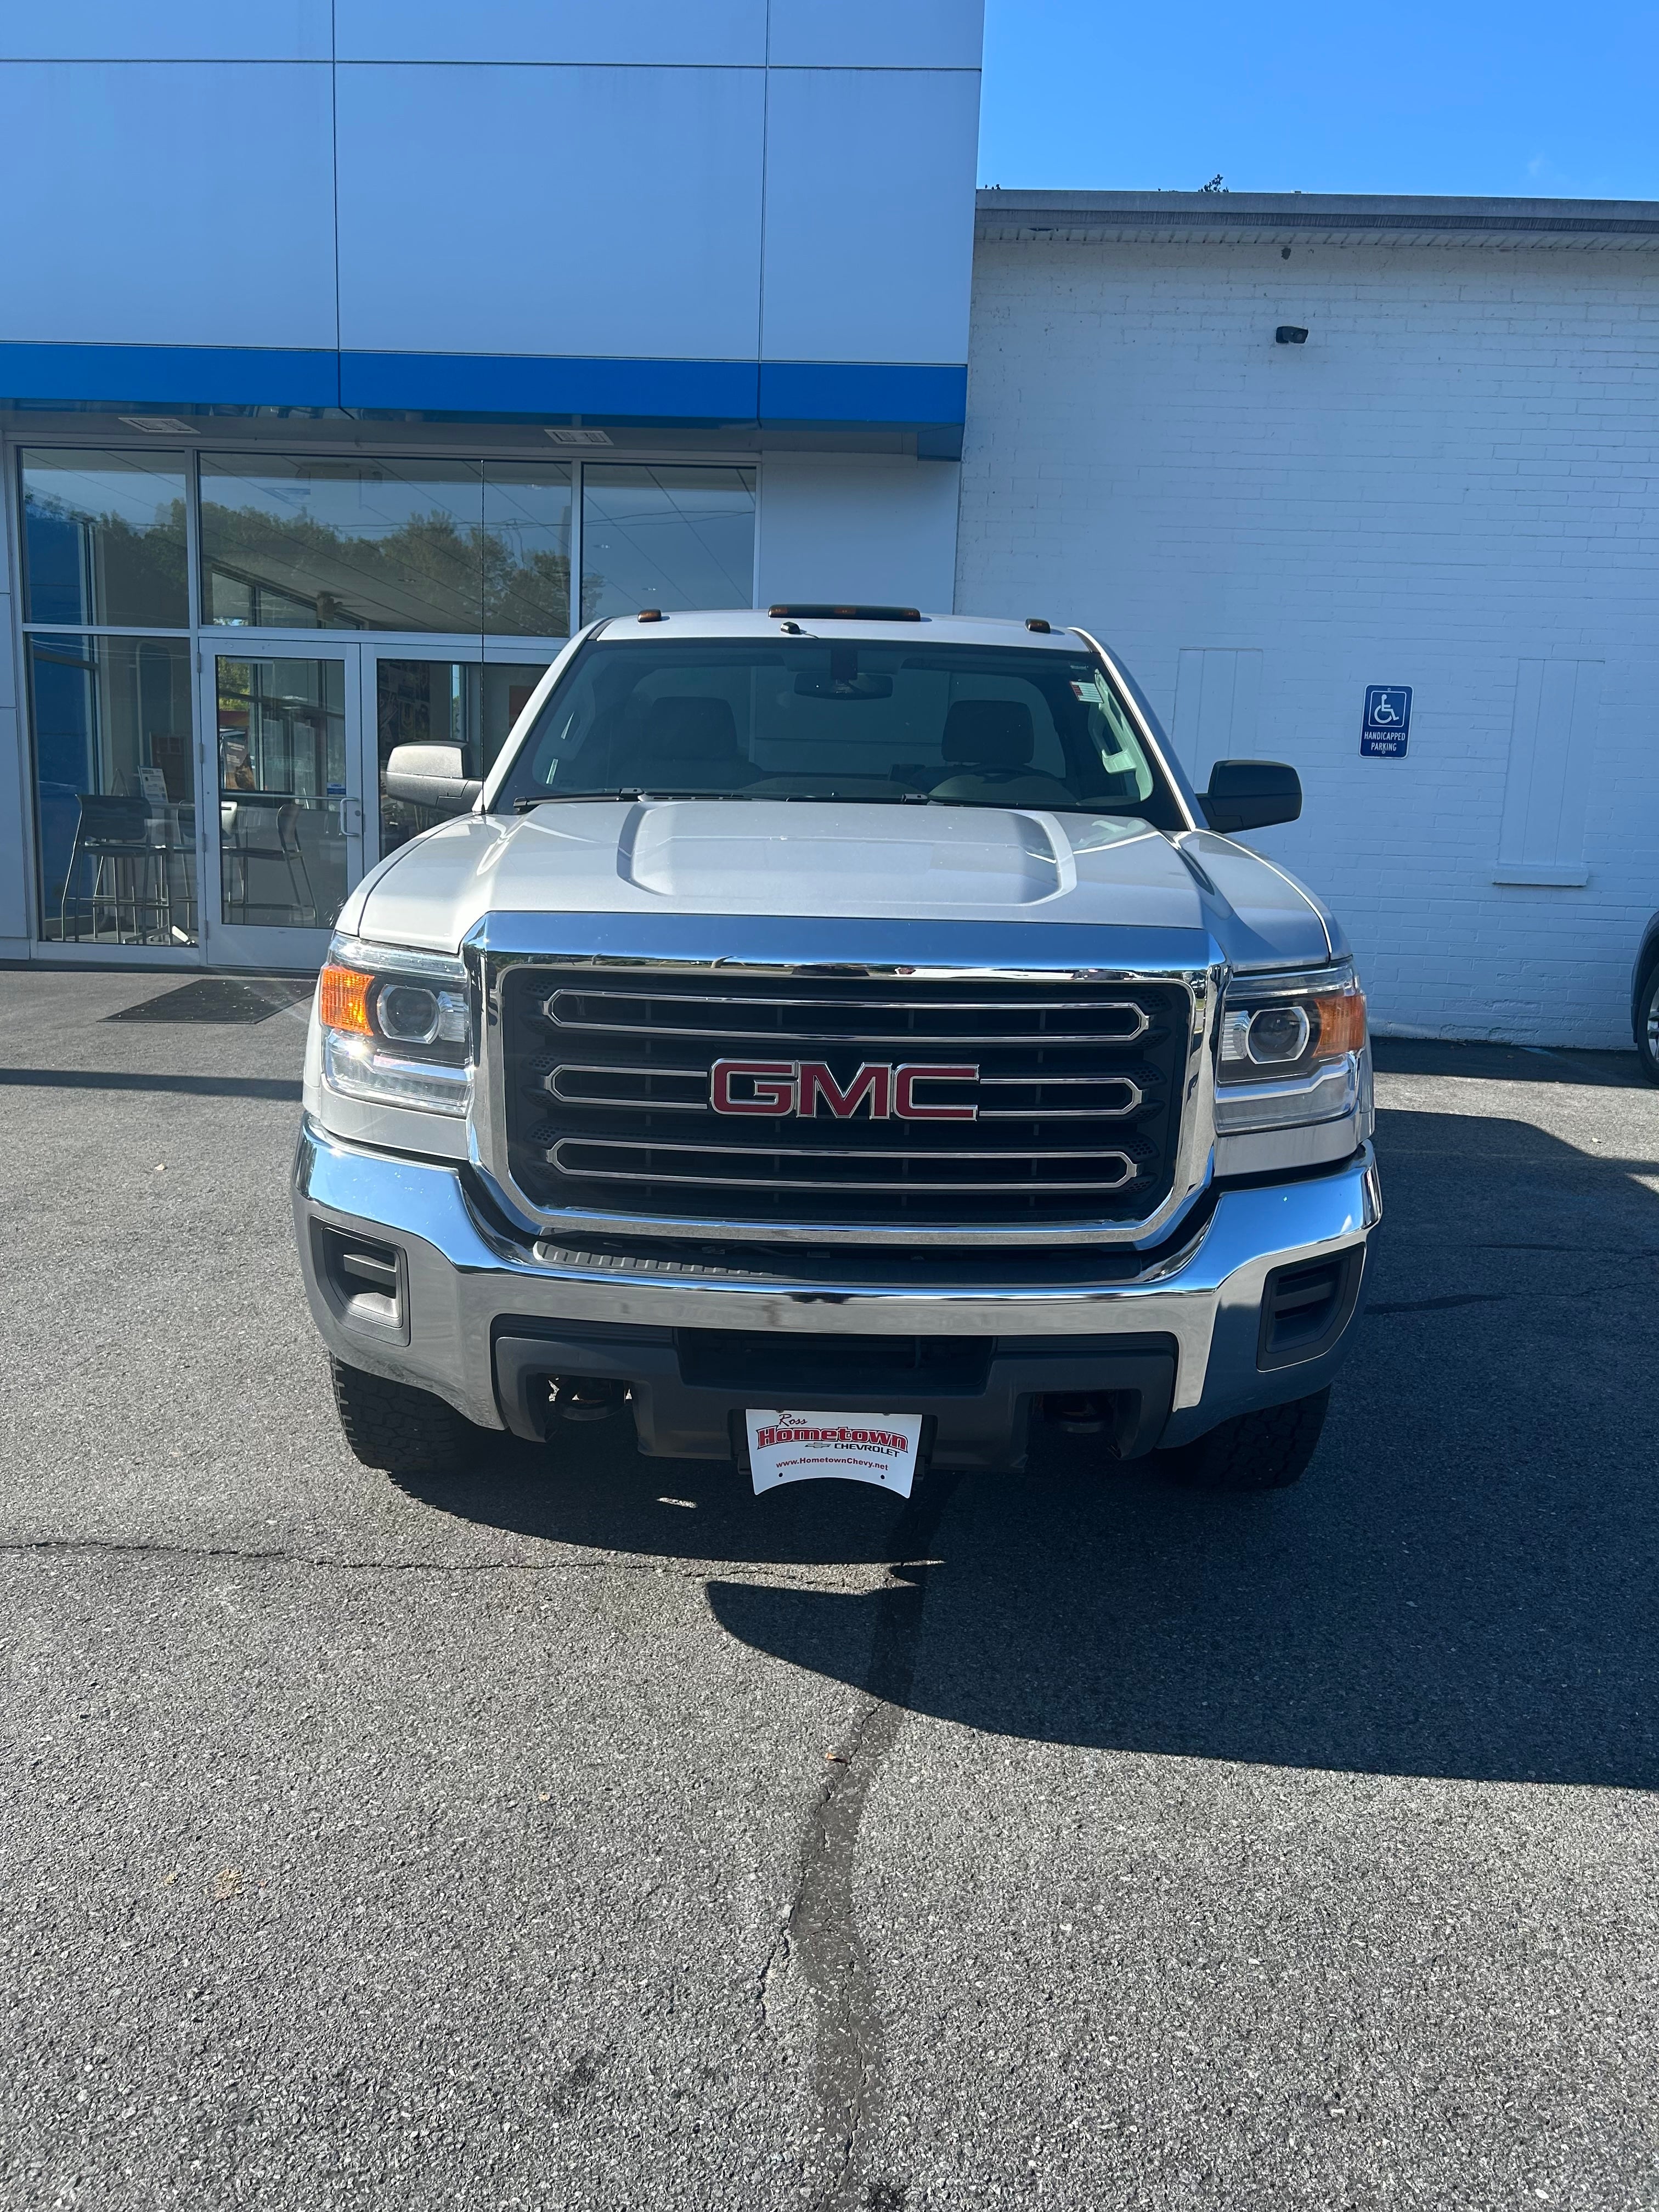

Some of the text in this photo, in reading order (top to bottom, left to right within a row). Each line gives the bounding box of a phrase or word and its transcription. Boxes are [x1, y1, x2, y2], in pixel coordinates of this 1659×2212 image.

[1364, 731, 1406, 741] HANDICAPPED
[1371, 742, 1397, 751] PARKING
[710, 1058, 979, 1121] GMC
[778, 1413, 808, 1426] Ross
[756, 1425, 909, 1453] Hometown
[834, 1443, 900, 1458] CHEVROLET
[776, 1457, 889, 1471] www.HometownChevy.net
